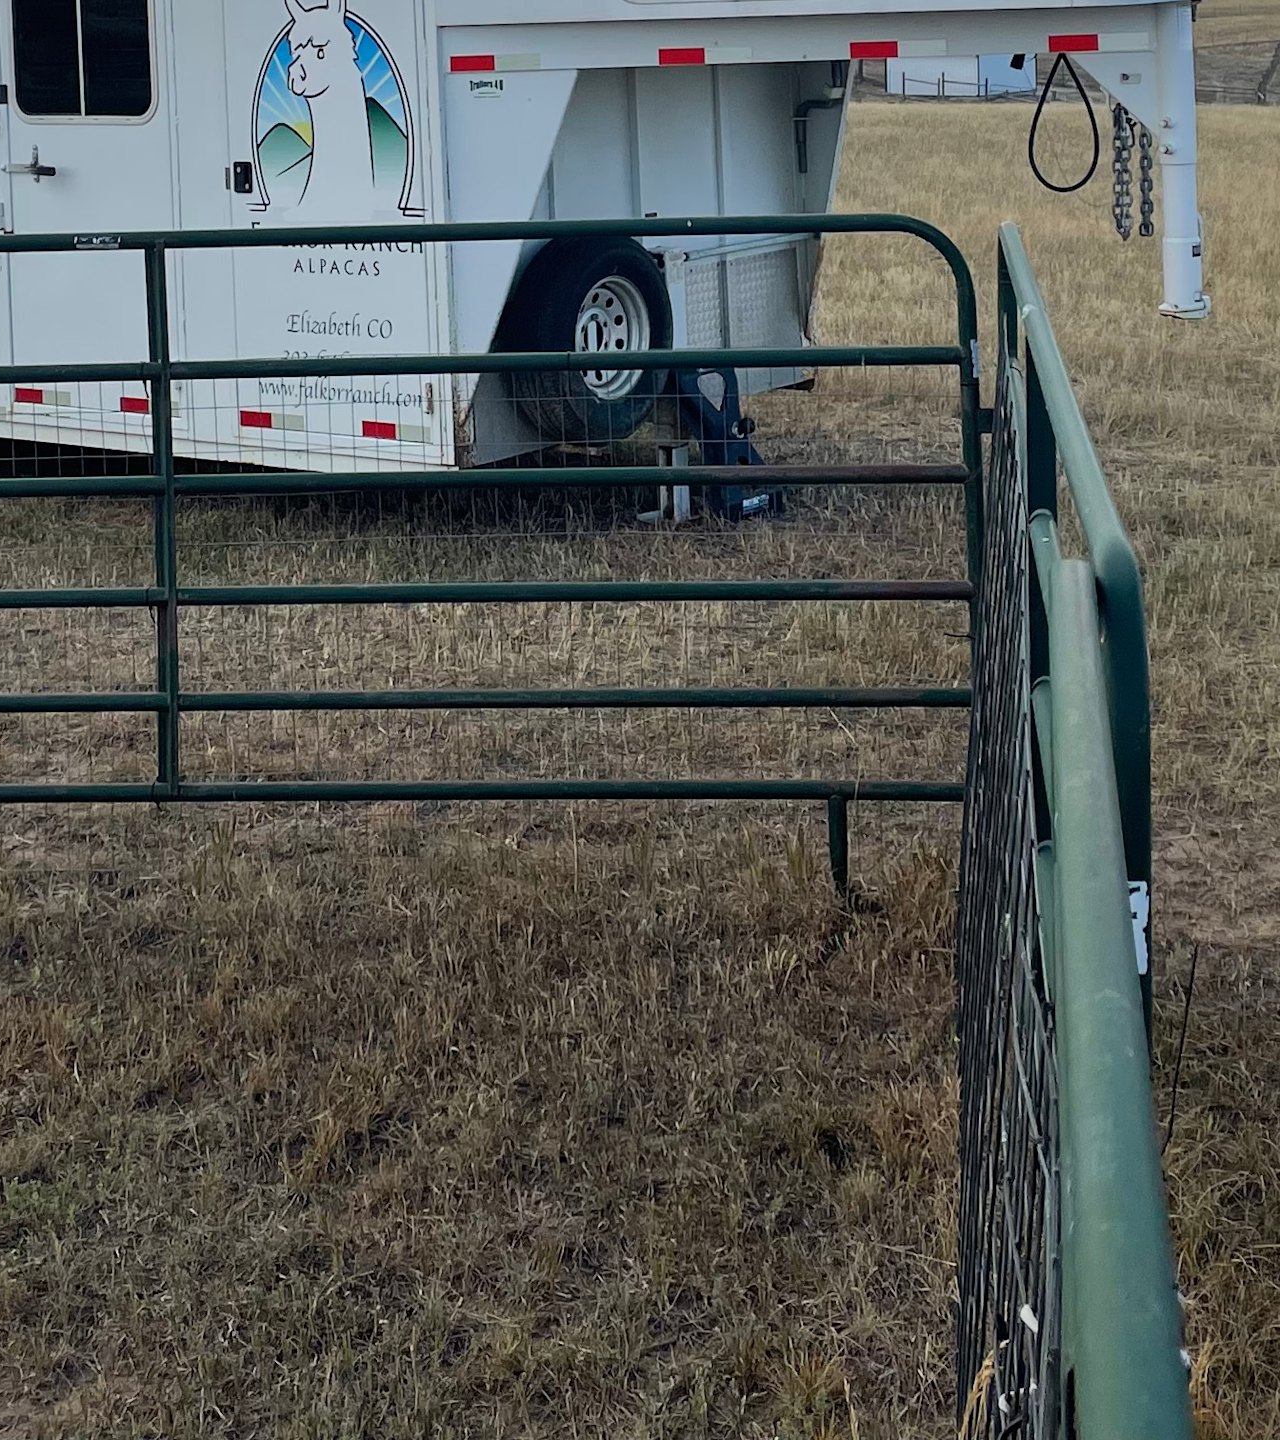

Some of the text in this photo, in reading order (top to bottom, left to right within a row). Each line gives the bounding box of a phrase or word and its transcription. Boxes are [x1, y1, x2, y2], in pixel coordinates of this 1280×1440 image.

[293, 258, 381, 276] ALPACAS
[287, 310, 393, 339] Elizabeth CO
